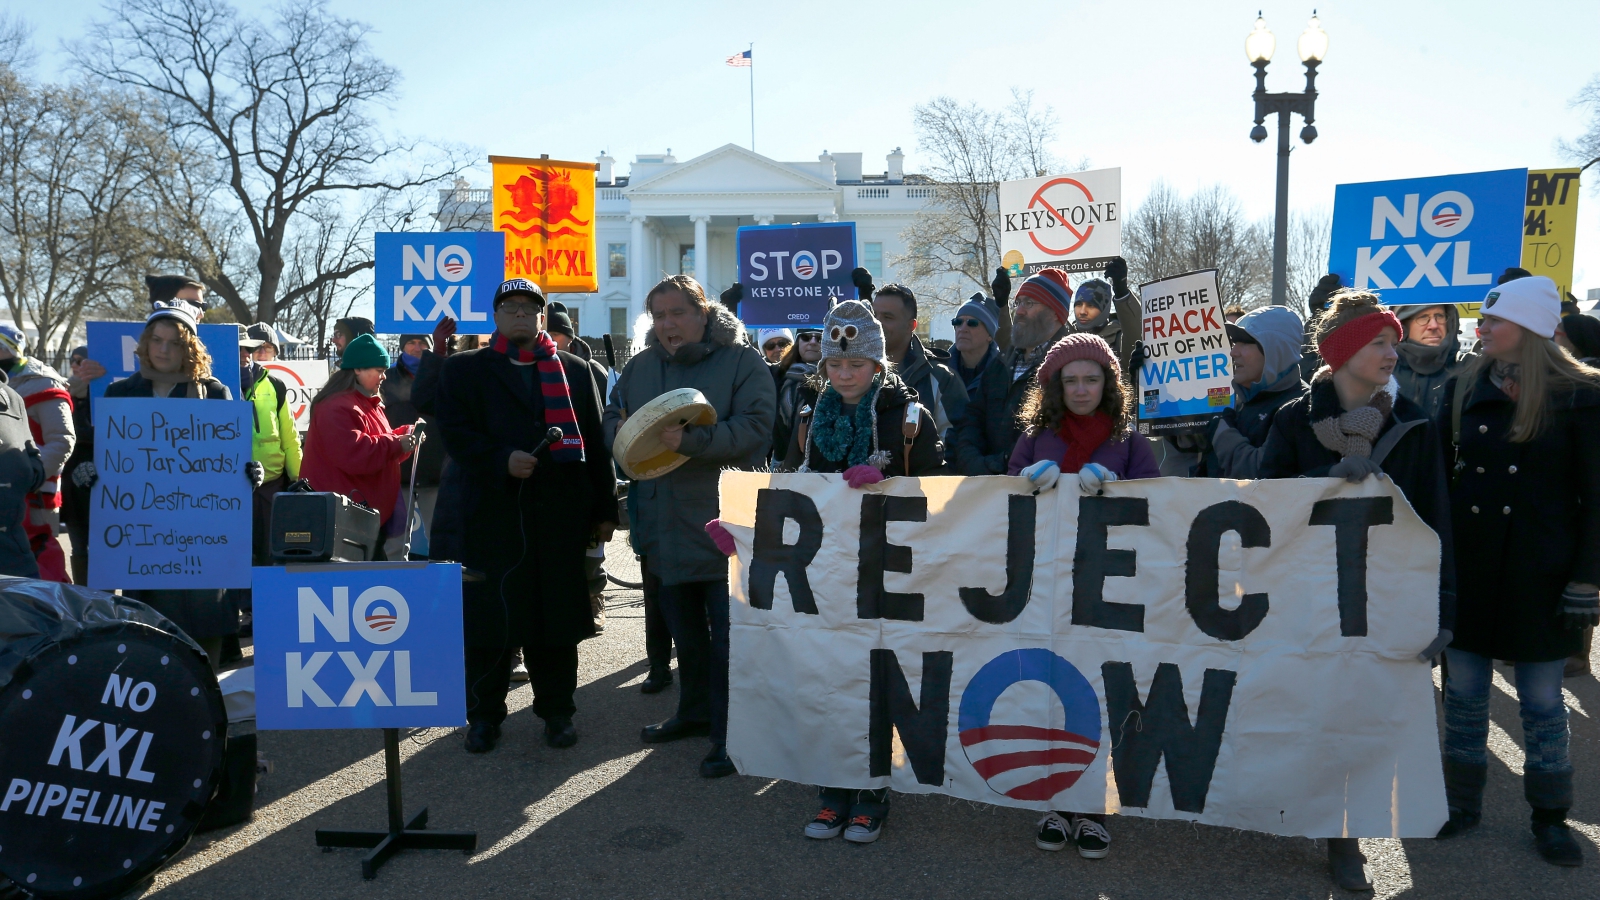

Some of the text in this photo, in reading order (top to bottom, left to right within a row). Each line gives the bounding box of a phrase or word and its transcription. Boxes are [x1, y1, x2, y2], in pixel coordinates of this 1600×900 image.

[1004, 202, 1117, 232] KEYSTONE
[1370, 190, 1474, 241] NO
[402, 245, 472, 282] NO
[505, 248, 592, 276] #NoKXL
[749, 250, 843, 281] STOP
[1354, 241, 1492, 290] KXL
[1528, 242, 1562, 268] TO
[393, 286, 487, 321] KXL
[751, 285, 845, 298] KEYSTONE XL
[1145, 288, 1209, 314] KEEP THE
[1142, 306, 1221, 341] FRACK
[1143, 334, 1223, 359] OUT OF MY
[1142, 353, 1229, 386] WATER
[107, 411, 241, 448] No Pipelines!
[1151, 421, 1210, 430] SIERRACLUB.ORG/FRACKIN
[105, 446, 239, 474] No Tar Sands!
[101, 481, 241, 511] No Destruction
[104, 523, 228, 552] Of Indigenous
[128, 555, 201, 575] Lands!!!
[748, 488, 1394, 641] REJECT
[297, 586, 410, 645] NO
[101, 673, 157, 713] NO
[286, 650, 438, 708] KXL
[868, 648, 1237, 813] NOW
[47, 714, 156, 784] KXL
[0, 778, 166, 832] PIPELINE
